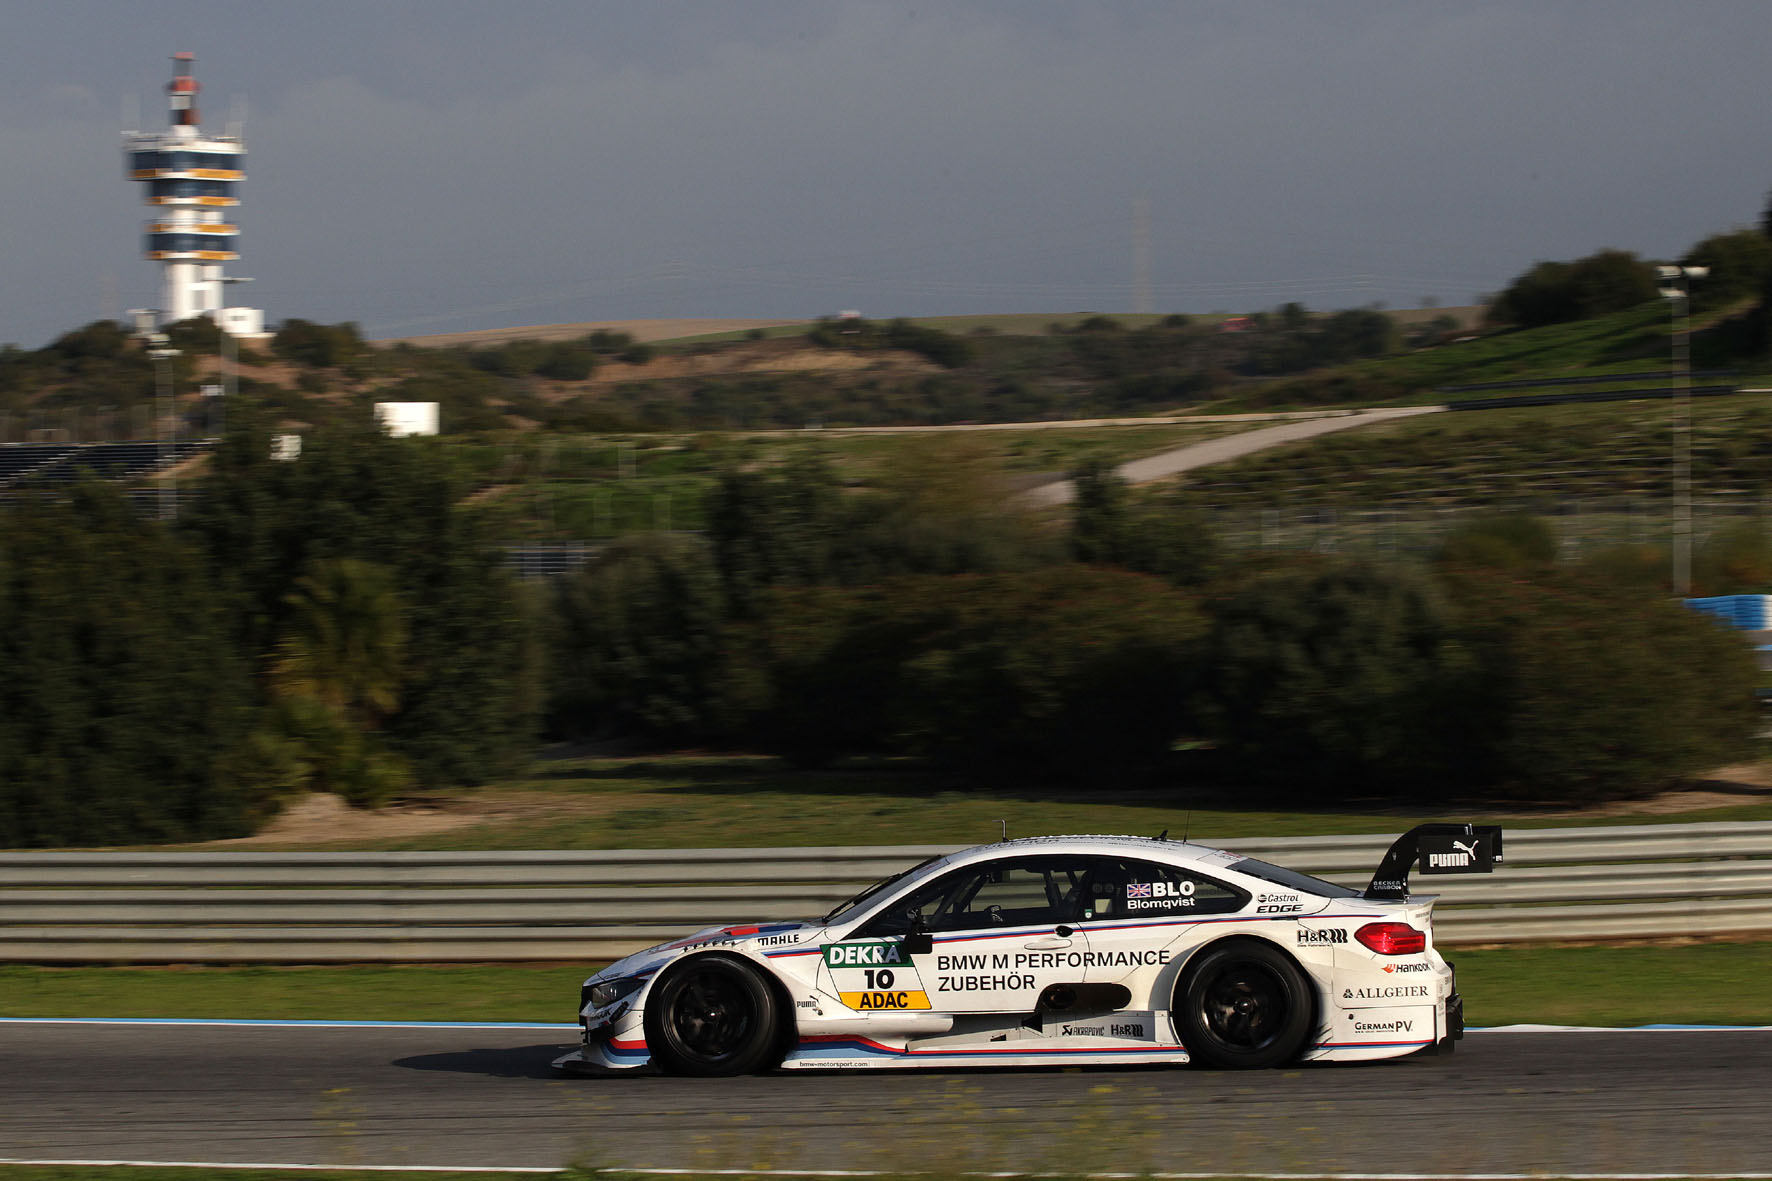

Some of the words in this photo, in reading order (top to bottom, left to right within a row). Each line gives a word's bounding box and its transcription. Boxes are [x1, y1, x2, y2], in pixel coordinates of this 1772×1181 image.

[1429, 852, 1469, 868] PUMA
[1152, 881, 1195, 897] BLO
[1127, 897, 1195, 910] Blomqvist
[1267, 893, 1299, 903] Castrol
[1256, 904, 1304, 914] EDGE
[758, 934, 800, 946] MAHLE
[1297, 929, 1328, 942] H&R
[829, 944, 901, 965] DEKRA
[937, 954, 987, 970] BMW
[992, 954, 1008, 969] M
[1015, 950, 1171, 968] PERFORMANCE
[864, 969, 895, 990] 10
[938, 972, 1036, 992] ZUBEHÖR
[1355, 986, 1429, 999] ALLGEIER
[796, 1000, 817, 1008] PUMA
[860, 992, 908, 1009] ADAC
[799, 1061, 868, 1069] bmw-motorsport.com
